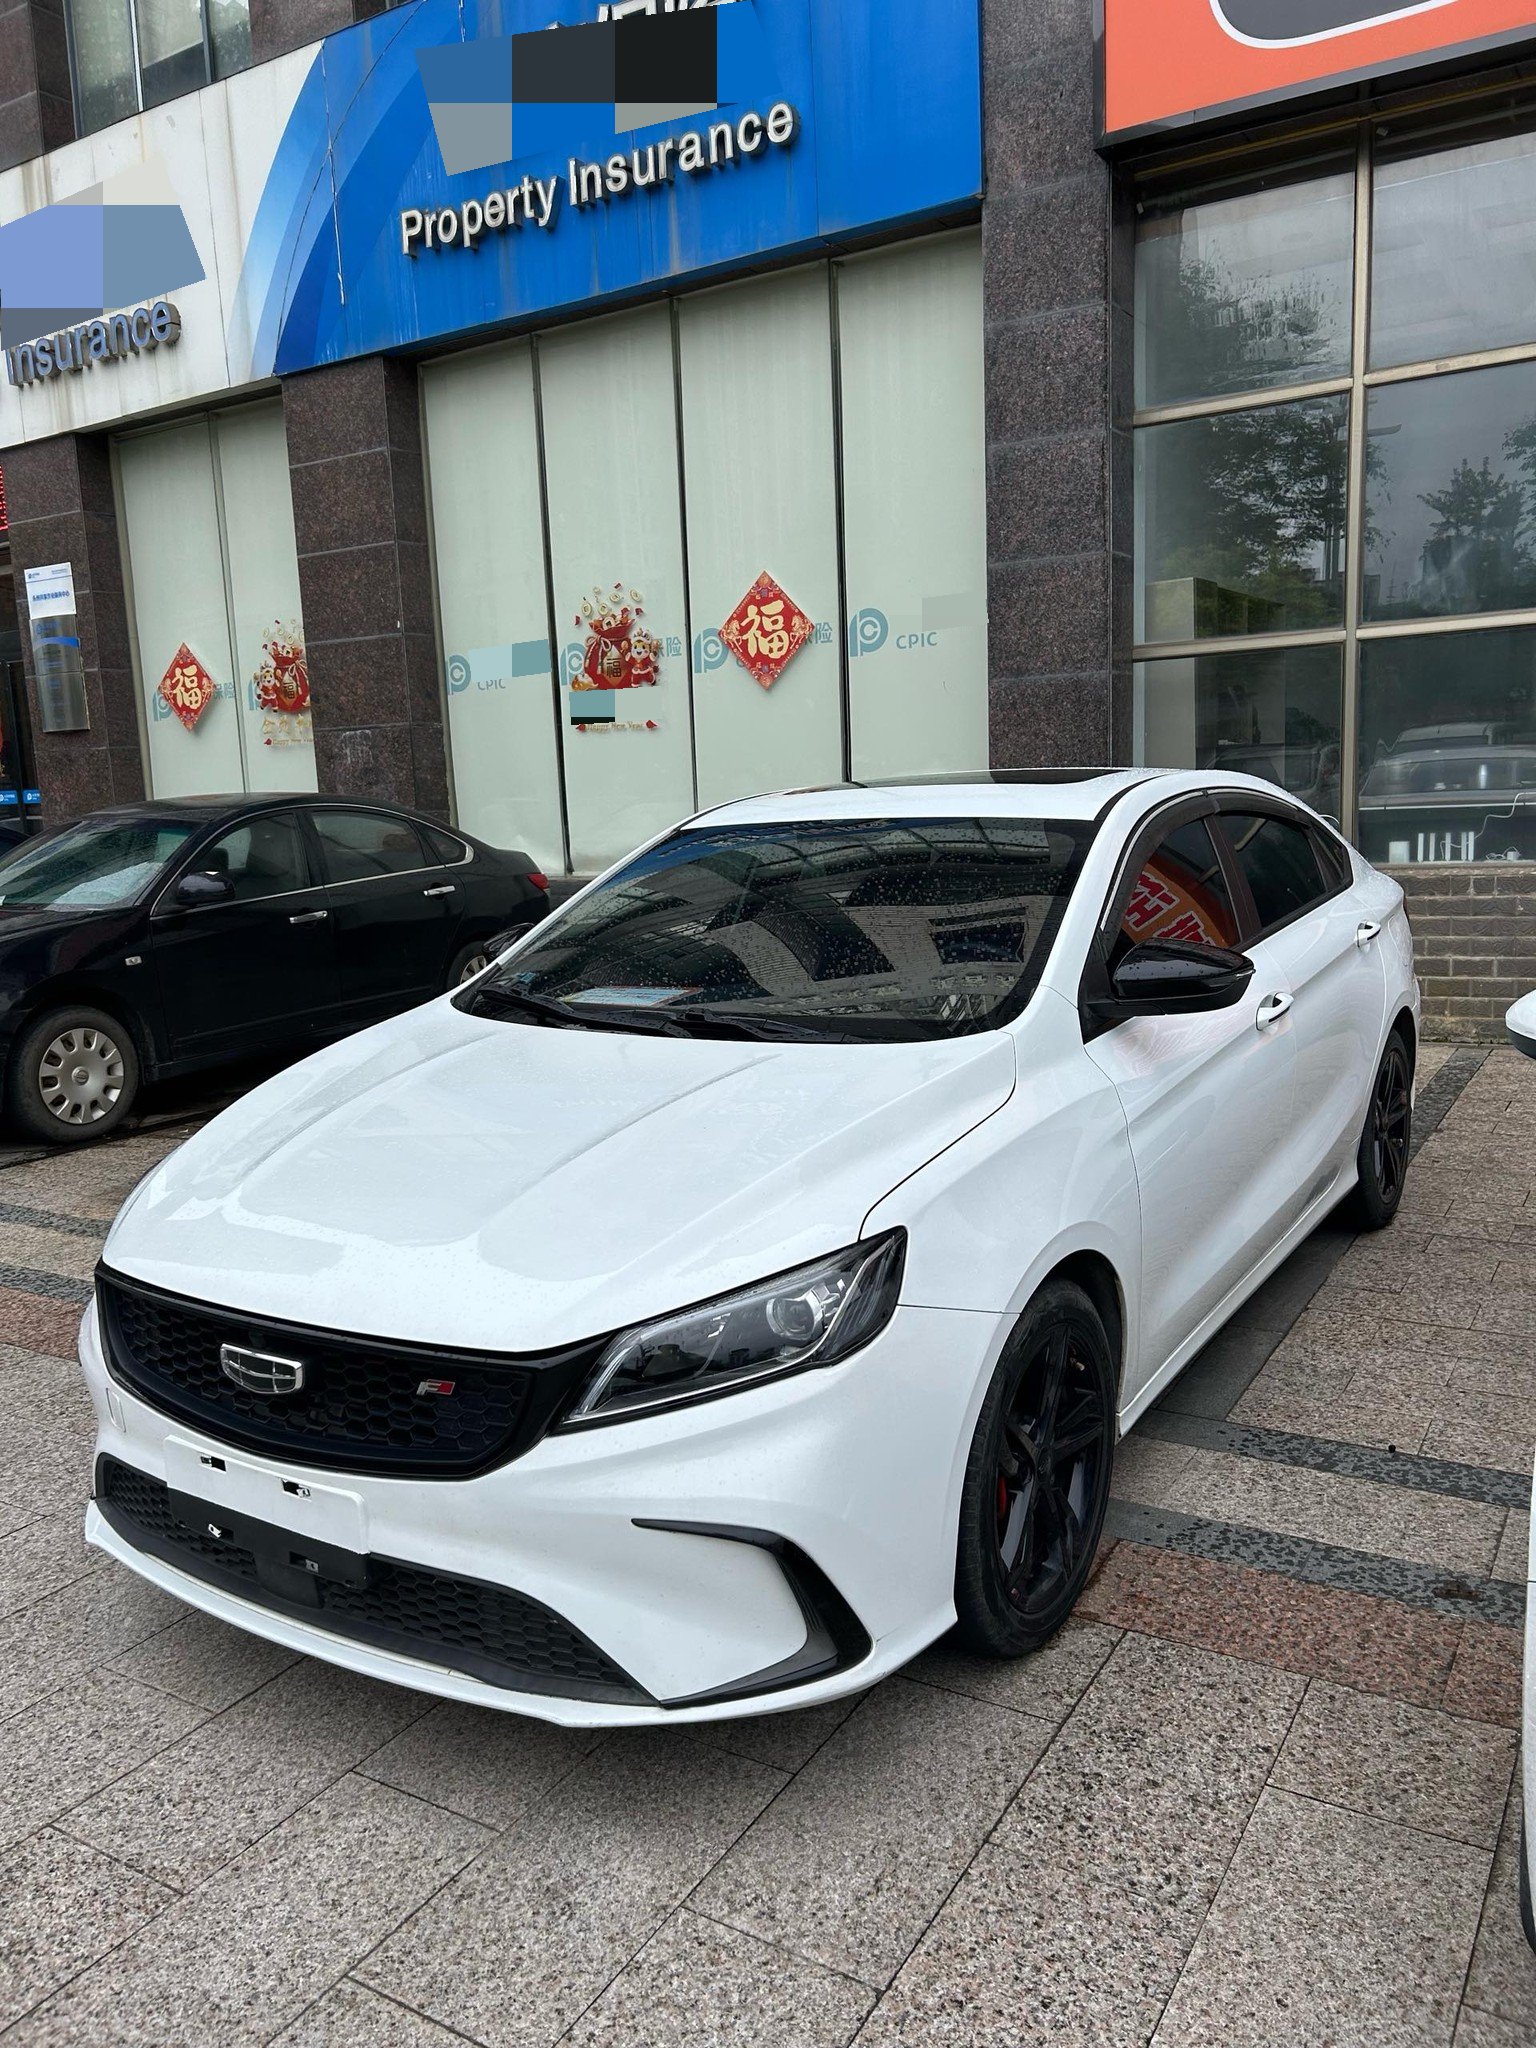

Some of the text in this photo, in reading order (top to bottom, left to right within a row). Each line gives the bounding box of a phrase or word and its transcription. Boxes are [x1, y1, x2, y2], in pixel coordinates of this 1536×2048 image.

[401, 101, 798, 256] Property Insurance
[741, 600, 790, 659] 福
[896, 631, 938, 649] CPIC
[172, 664, 203, 710] 福
